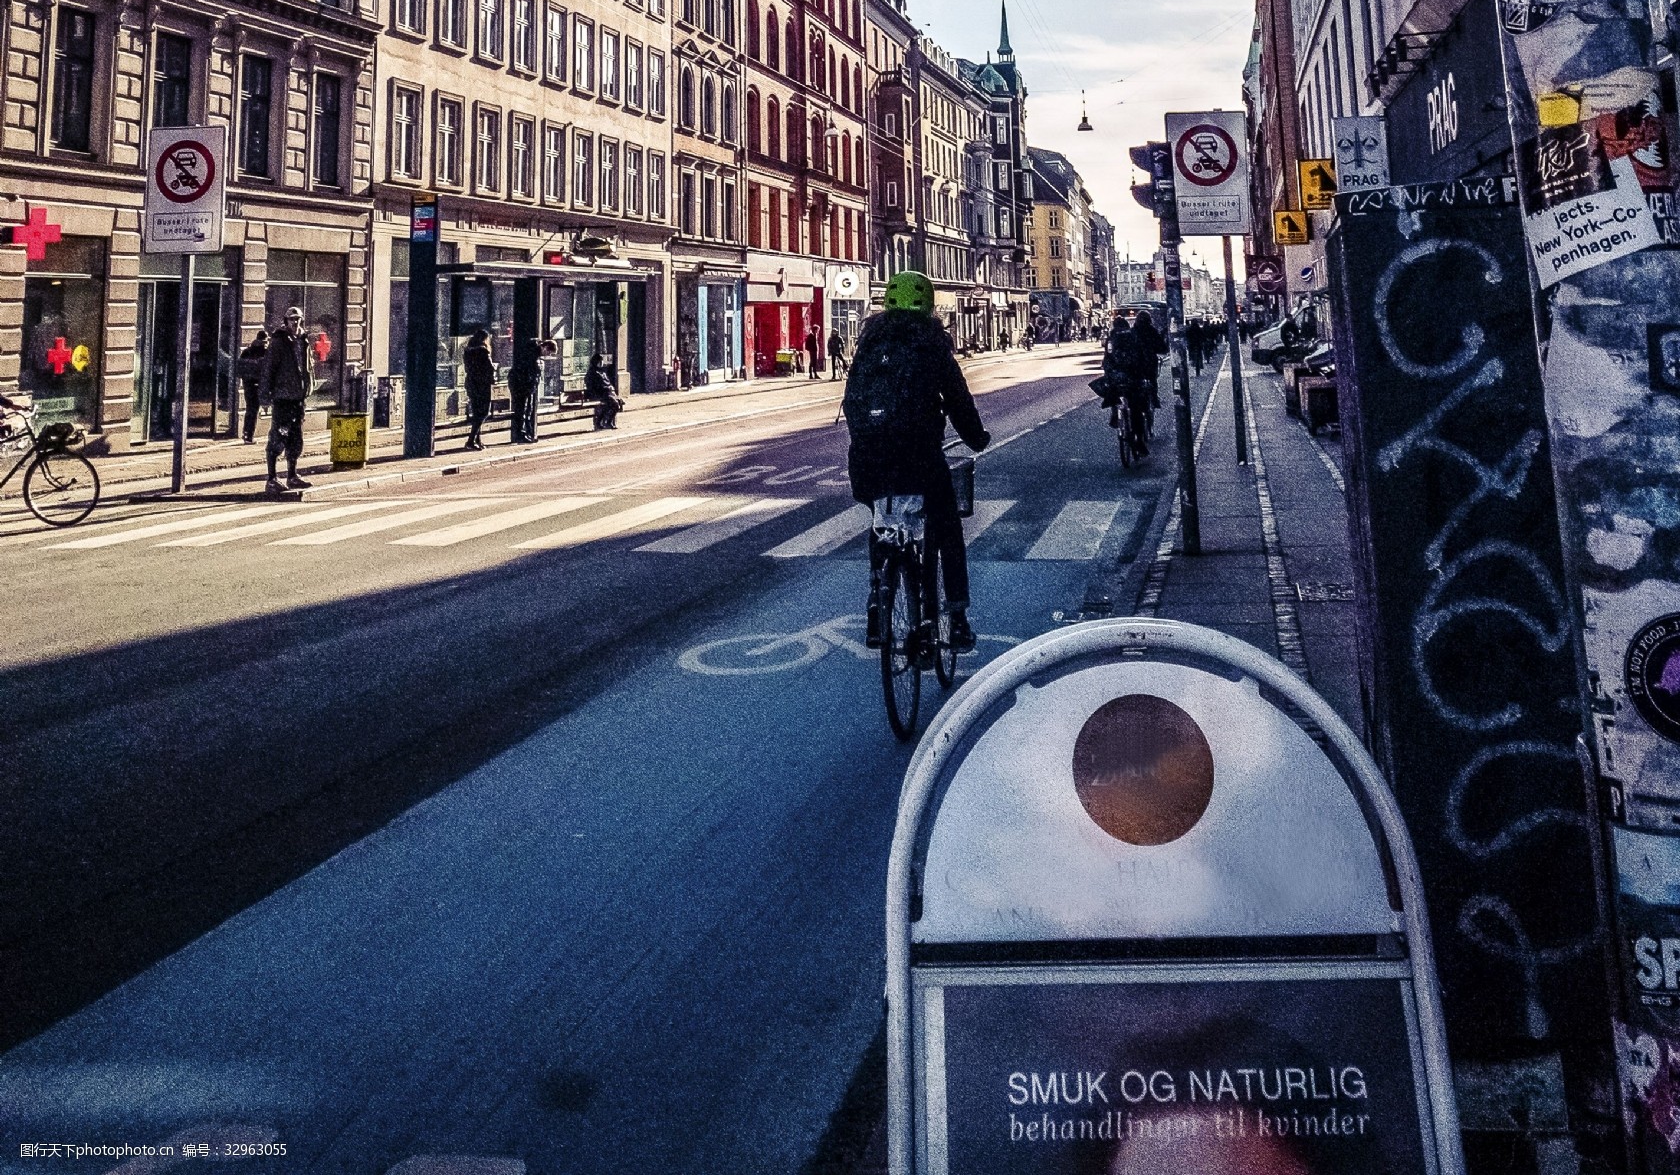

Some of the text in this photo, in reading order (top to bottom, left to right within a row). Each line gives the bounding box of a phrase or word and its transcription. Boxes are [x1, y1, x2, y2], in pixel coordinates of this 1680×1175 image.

[1426, 72, 1457, 155] PRAG
[1343, 175, 1379, 186] PRAG
[1189, 210, 1228, 218] undtaget
[1552, 199, 1600, 229] jects.
[1534, 235, 1562, 259] New
[1551, 229, 1637, 271] penhagen.
[1630, 649, 1644, 675] NOT
[1640, 625, 1666, 650] FOOD
[1008, 1066, 1369, 1105] SMUK OG NATURLIG
[1214, 1109, 1247, 1139] til
[1258, 1107, 1371, 1138] kvinder
